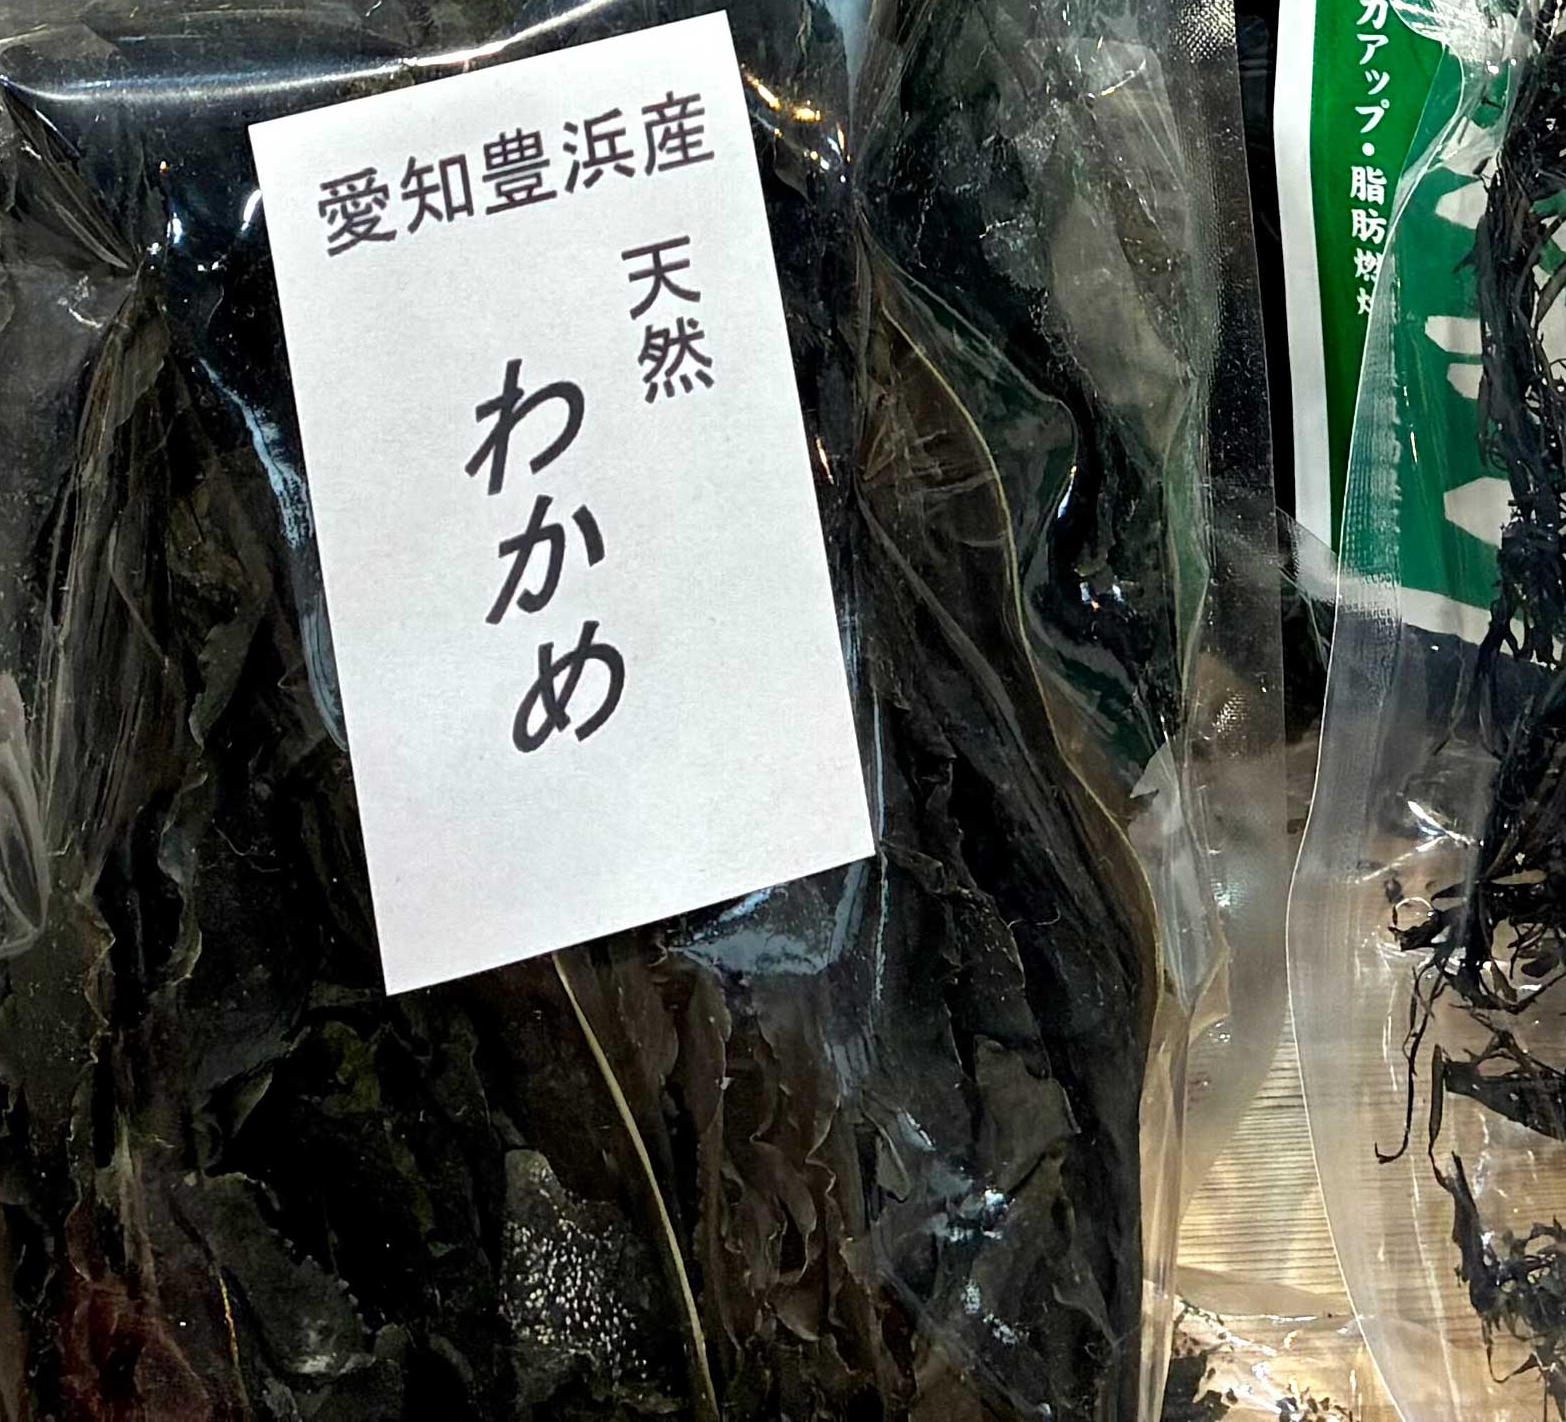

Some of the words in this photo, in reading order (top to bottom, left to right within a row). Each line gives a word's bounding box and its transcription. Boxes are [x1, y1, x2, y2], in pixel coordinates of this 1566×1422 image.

[317, 89, 716, 257] 愛知豊浜産
[621, 233, 716, 405] 天然
[464, 358, 627, 755] わかめ
